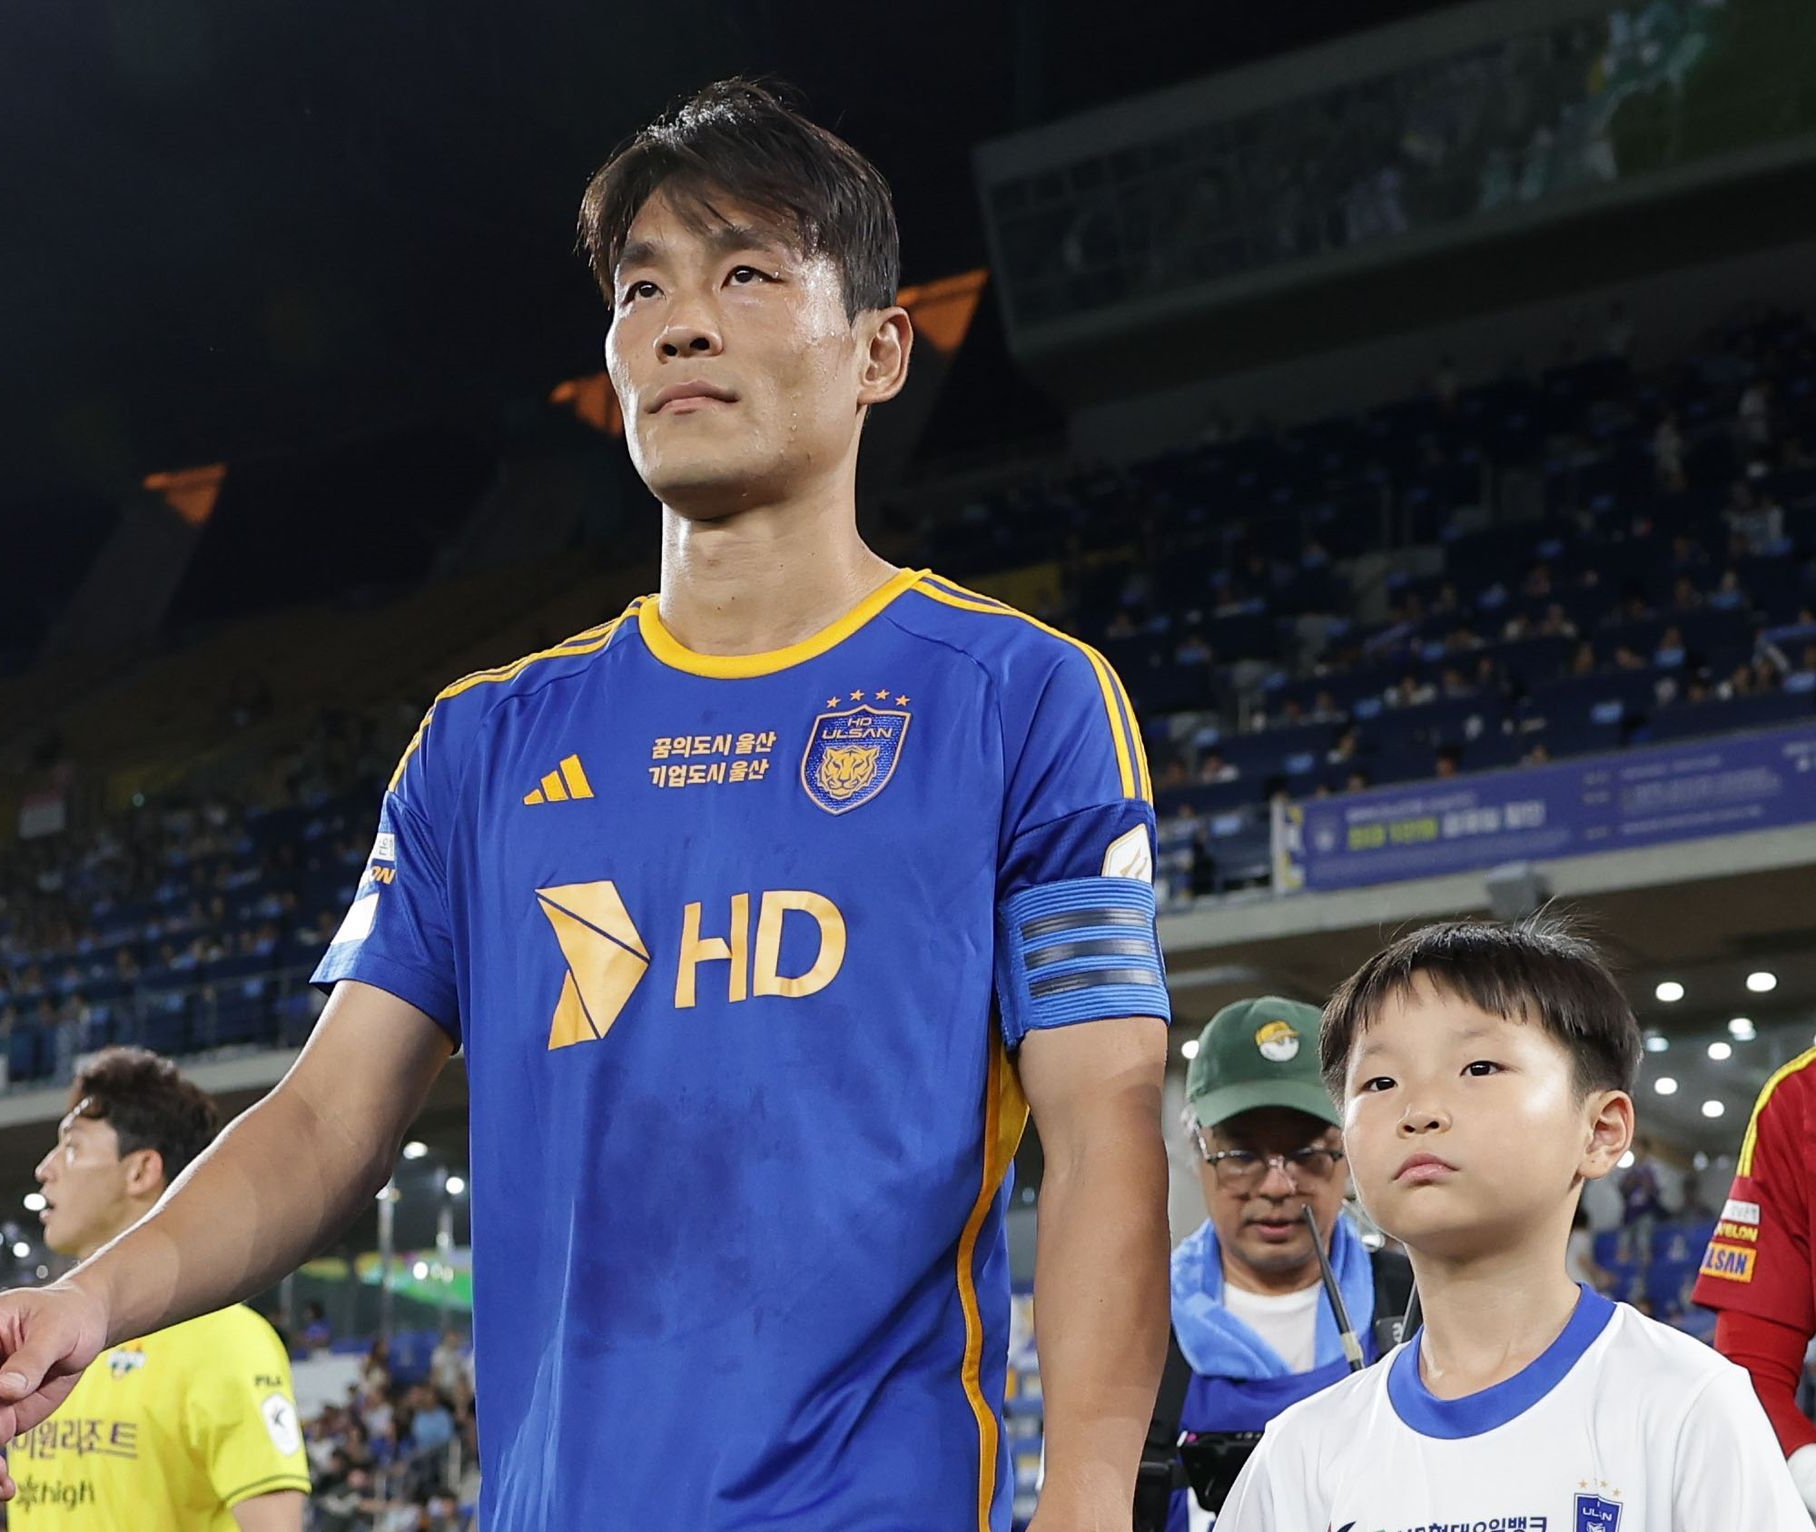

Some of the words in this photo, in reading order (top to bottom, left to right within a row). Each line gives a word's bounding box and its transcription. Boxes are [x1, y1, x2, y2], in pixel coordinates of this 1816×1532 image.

[822, 728, 893, 740] ULSAN
[848, 717, 872, 727] HD
[651, 733, 733, 760] 꿈의도시
[735, 731, 777, 756] 울산
[648, 761, 726, 788] 기업도시
[729, 758, 770, 782] 울산
[674, 889, 847, 1009] HD
[1703, 1247, 1748, 1275] LSAN
[9, 1416, 138, 1460] 이원리조트
